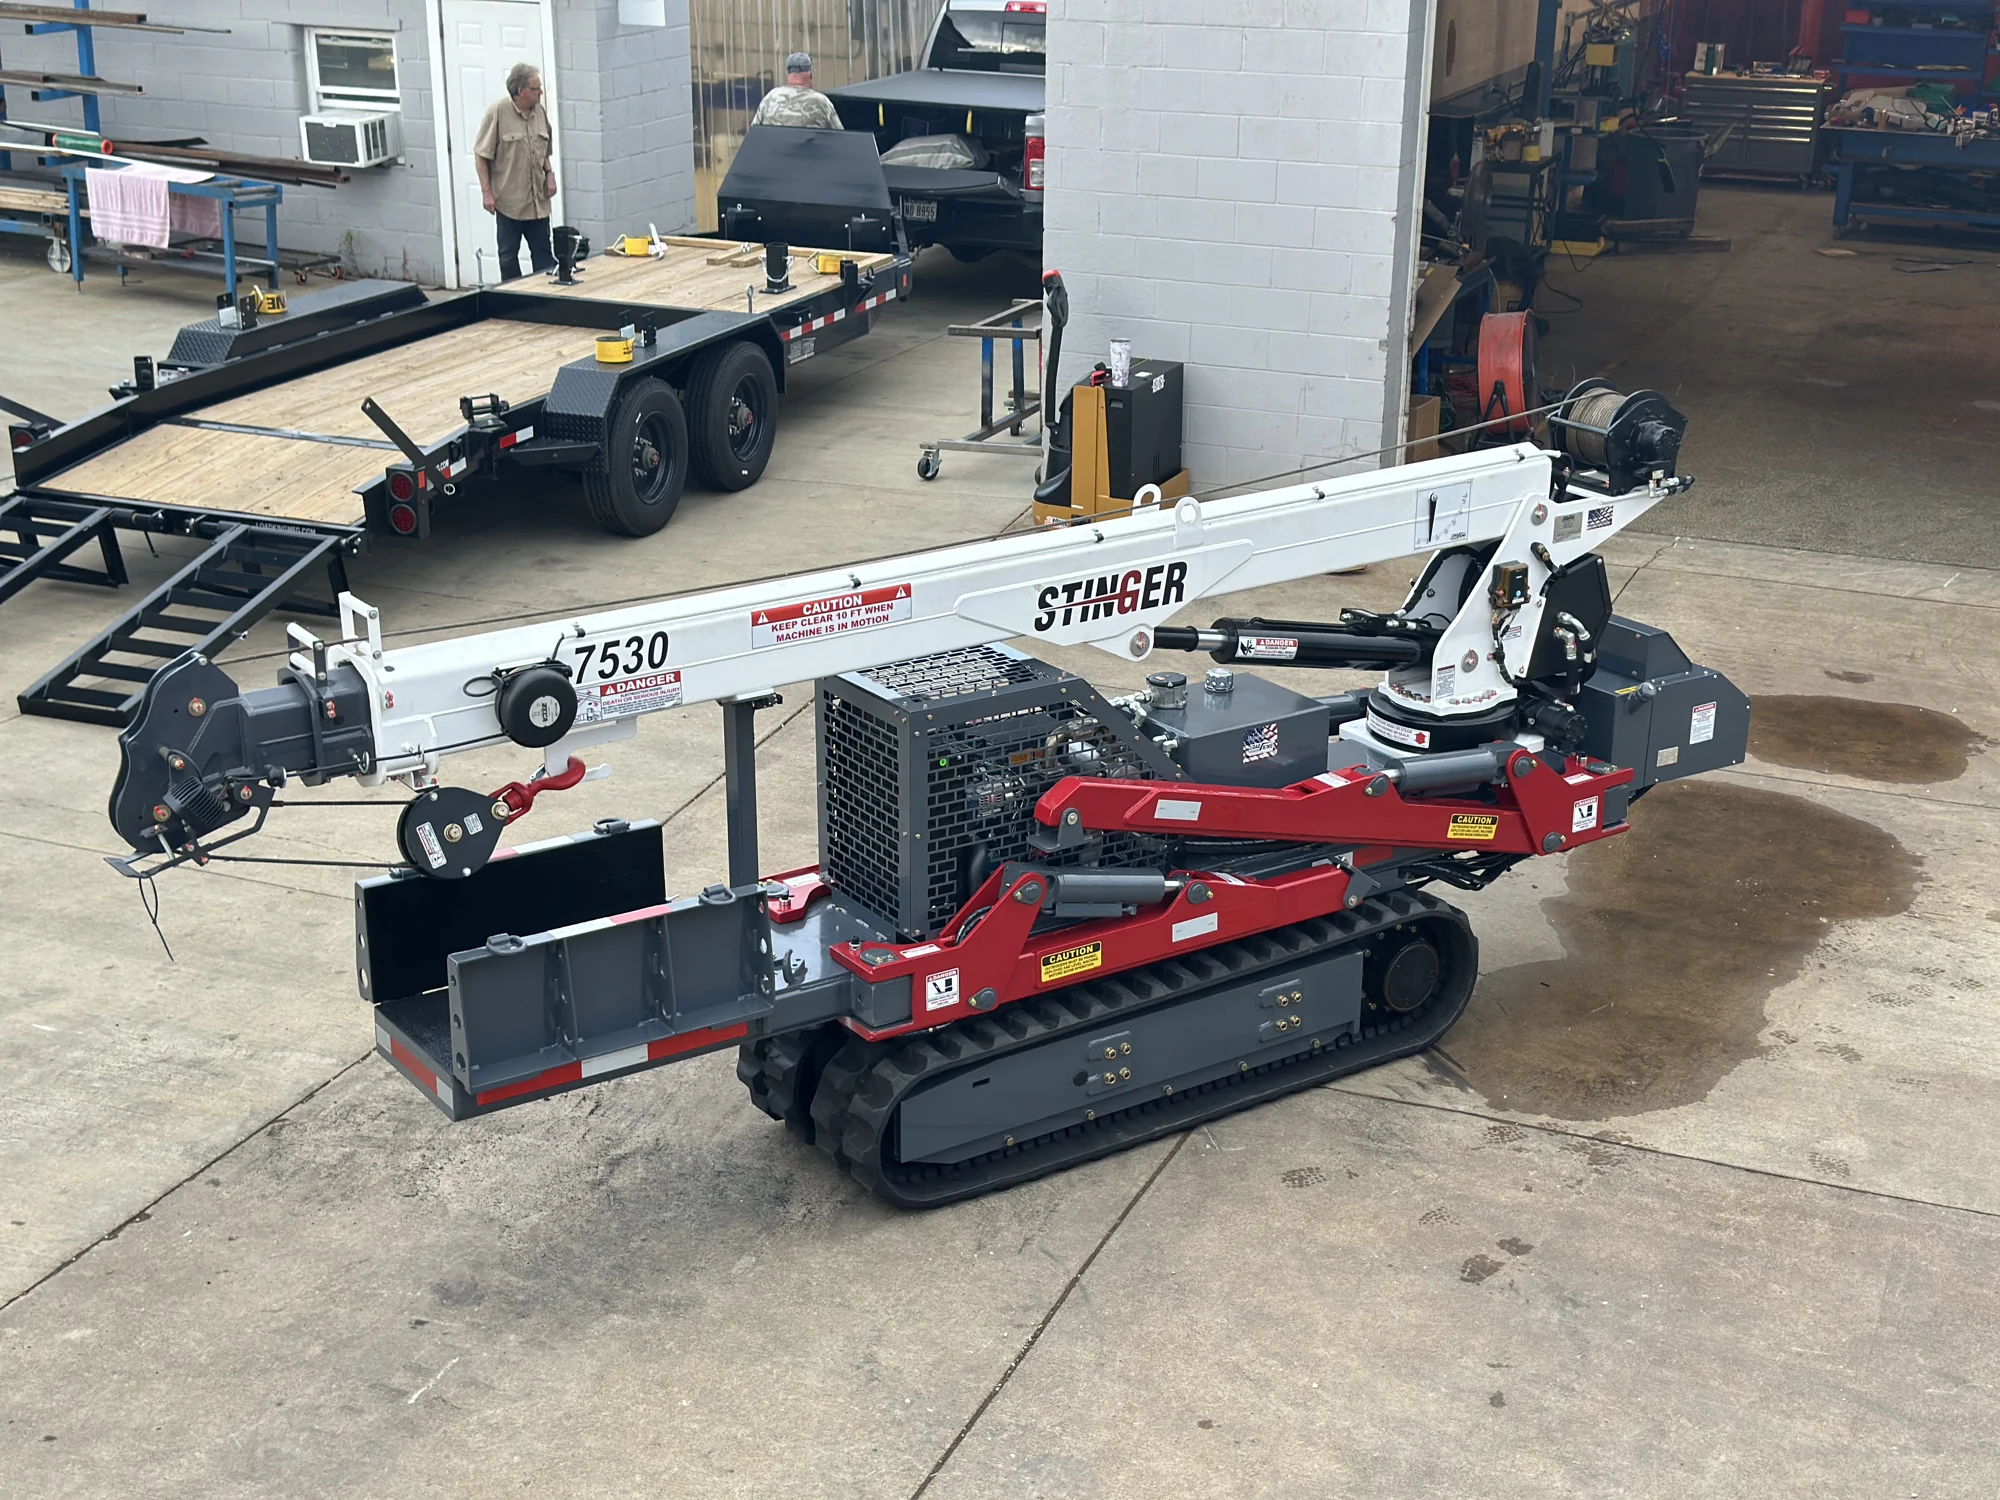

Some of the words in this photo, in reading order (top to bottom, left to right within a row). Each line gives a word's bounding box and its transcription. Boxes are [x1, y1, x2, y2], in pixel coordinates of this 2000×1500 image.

[803, 595, 862, 616] CAUTION
[1034, 561, 1187, 632] STINGER
[771, 620, 798, 632] KEEP
[801, 614, 833, 627] CLEAR
[837, 611, 847, 621] 10
[850, 608, 862, 618] FT
[865, 603, 894, 615] WHEN
[776, 627, 822, 642] MACHINE
[825, 624, 835, 633] IS
[838, 622, 848, 631] IN
[851, 614, 889, 628] MOTION
[1265, 639, 1293, 647] DANGER
[574, 630, 669, 685] 7530
[616, 673, 675, 692] DANGER
[603, 698, 622, 706] DEATH
[633, 691, 659, 701] SERIOUS
[659, 687, 681, 696] INJURY
[1457, 816, 1492, 824] CAUTION
[1049, 944, 1093, 964] CAUTION
